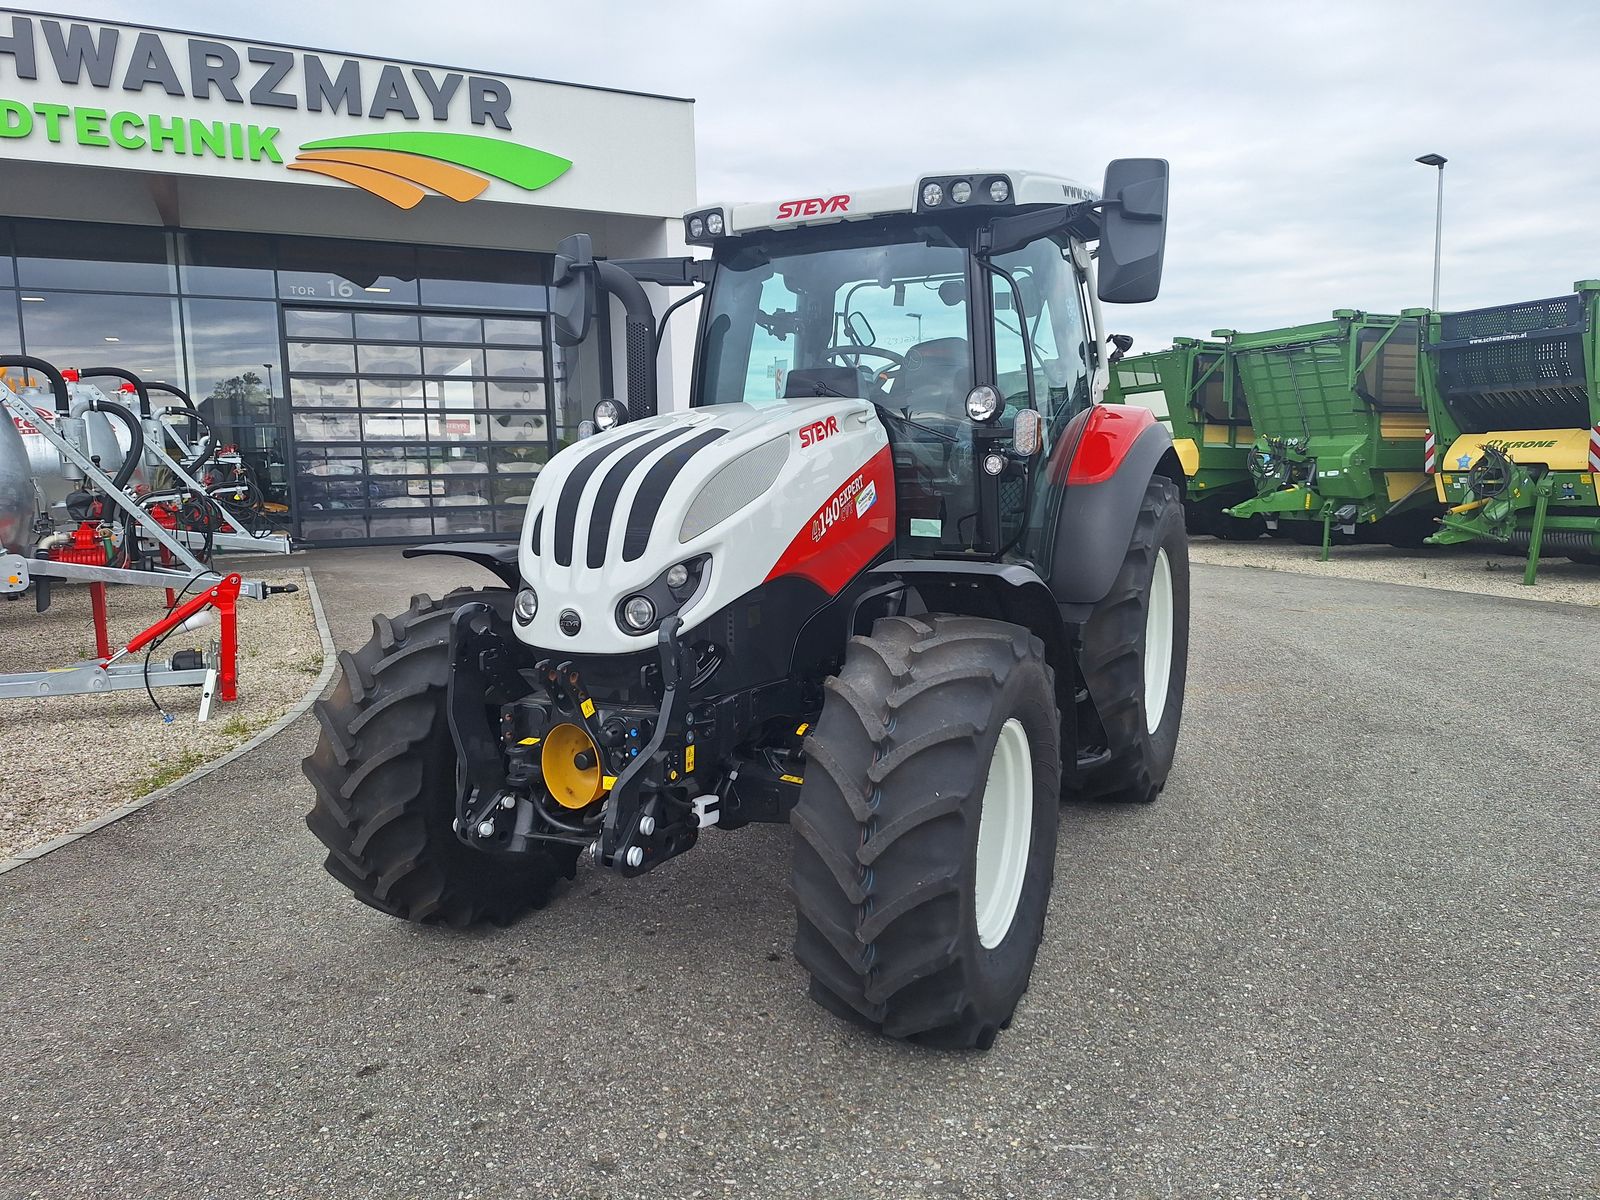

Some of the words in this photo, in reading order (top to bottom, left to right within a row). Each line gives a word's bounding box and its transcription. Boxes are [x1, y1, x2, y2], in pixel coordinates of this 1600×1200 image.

[0, 99, 284, 164] DTECHNIK
[776, 195, 850, 219] STEYR
[290, 286, 315, 295] TOR
[327, 279, 353, 297] 16
[799, 415, 839, 448] STEYR
[1501, 440, 1558, 449] KRONE
[839, 474, 864, 508] EXPERT
